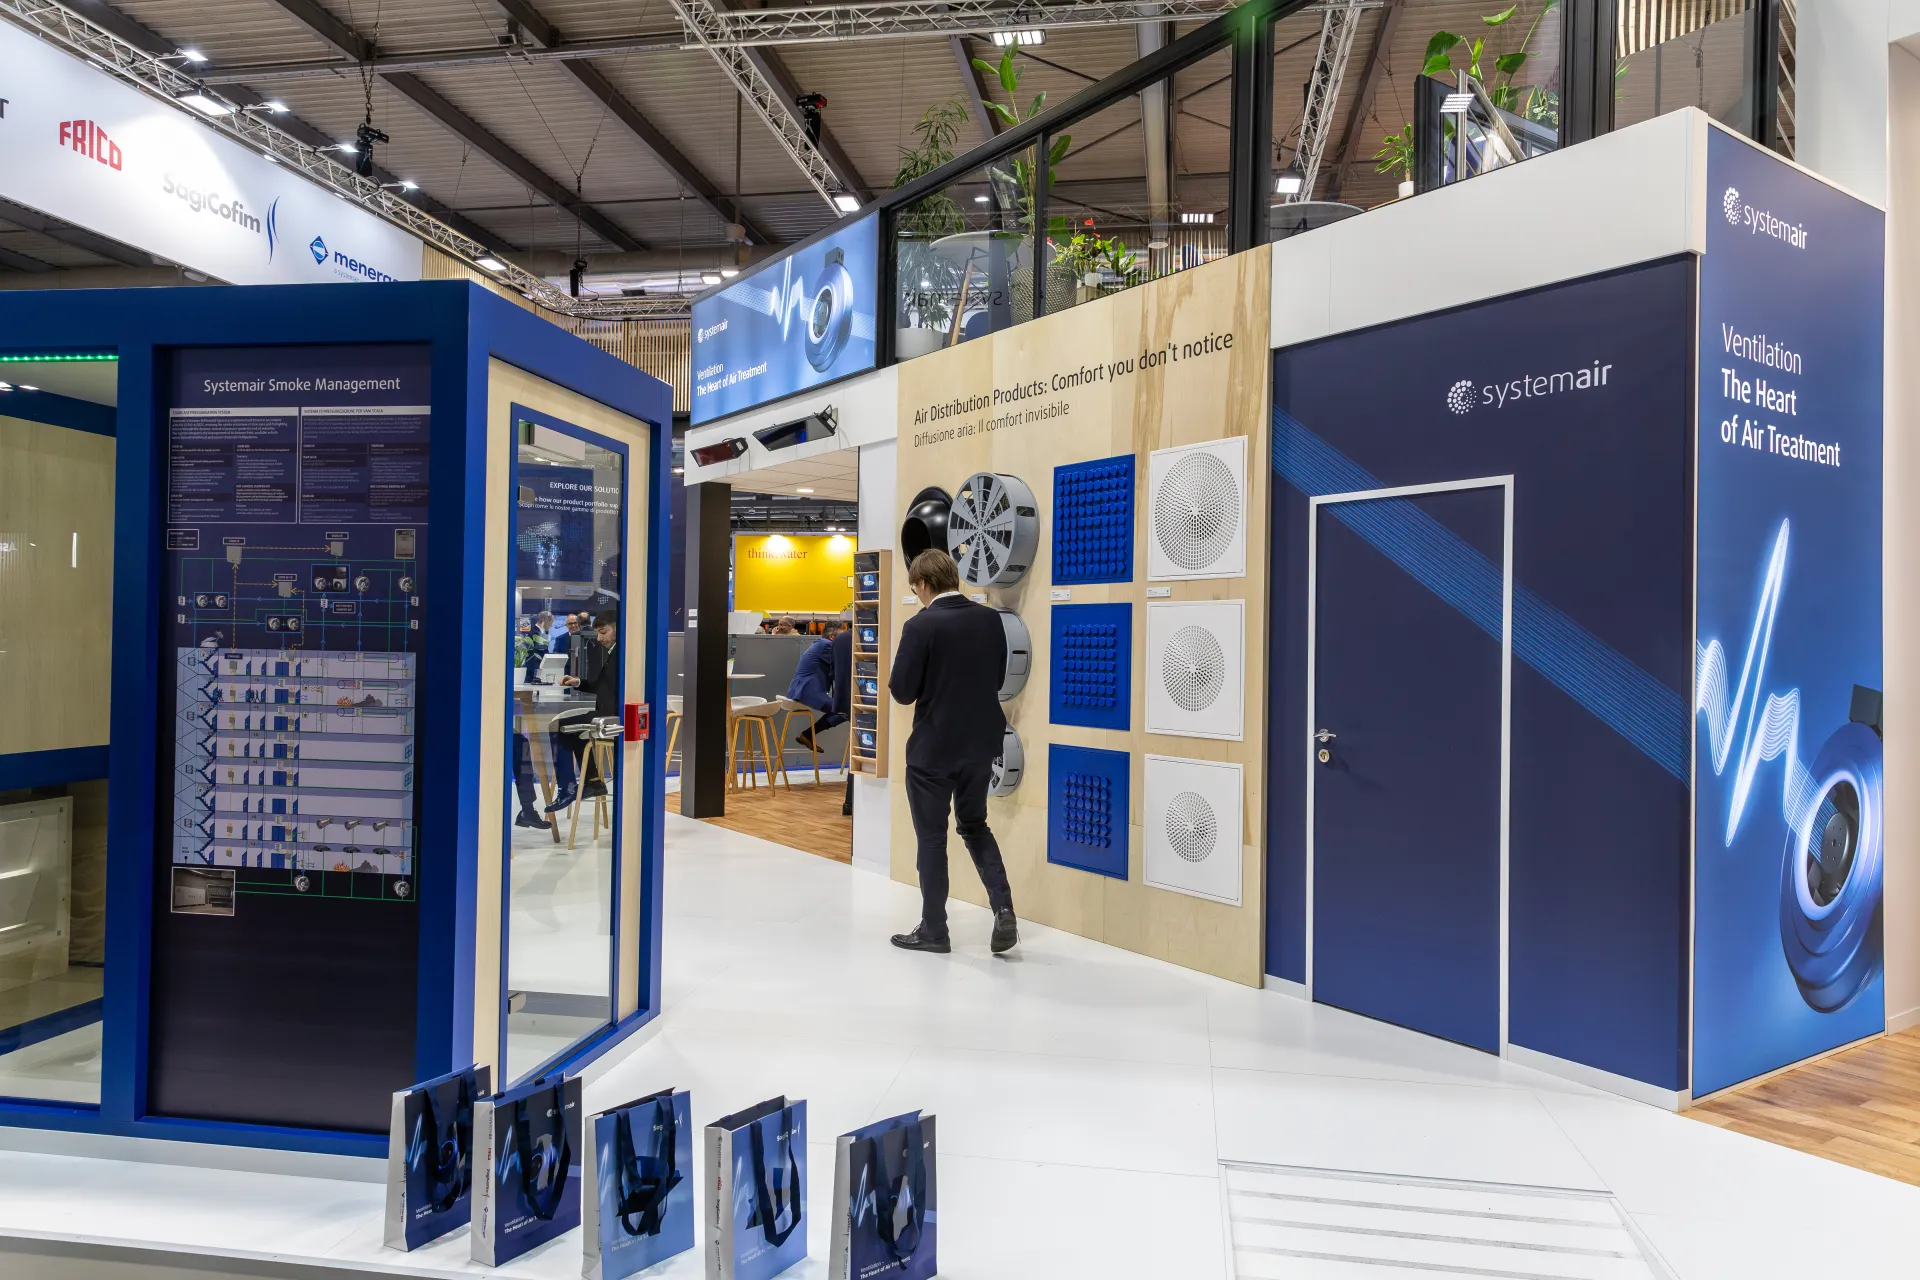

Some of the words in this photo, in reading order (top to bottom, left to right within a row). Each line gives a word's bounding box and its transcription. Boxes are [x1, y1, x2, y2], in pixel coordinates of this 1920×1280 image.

[59, 119, 122, 171] FRICO
[163, 171, 260, 233] SagiCofim
[1744, 204, 1807, 250] systemair
[334, 250, 399, 282] menerg
[704, 318, 728, 340] systemair
[1722, 322, 1802, 375] Ventilation
[204, 379, 264, 395] Systemair
[268, 377, 311, 392] Smoke
[314, 376, 401, 394] Management
[696, 363, 724, 381] Ventilation
[696, 384, 707, 397] The
[707, 378, 722, 394] Heart
[722, 374, 729, 388] of
[728, 372, 738, 386] Air
[737, 361, 767, 382] Treatment
[914, 408, 928, 426] Air
[930, 394, 990, 422] Distribution
[993, 383, 1048, 406] Products:
[1051, 363, 1104, 391] Comfort
[1108, 358, 1134, 382] you
[1139, 342, 1178, 370] don't
[1183, 332, 1233, 360] notice
[1482, 359, 1613, 408] systemair
[1721, 368, 1751, 404] The
[1755, 378, 1797, 416] Heart
[914, 429, 955, 448] Diffusione
[956, 423, 976, 438] aria:
[978, 418, 984, 433] Il
[986, 411, 1023, 432] comfort
[1025, 400, 1070, 424] invisibile
[1721, 414, 1739, 443] of
[1741, 419, 1765, 450] Air
[1767, 424, 1841, 467] Treatment
[549, 482, 578, 491] EXPLORE
[579, 484, 593, 492] OUR
[562, 498, 584, 507] product
[868, 1268, 880, 1277] Heart
